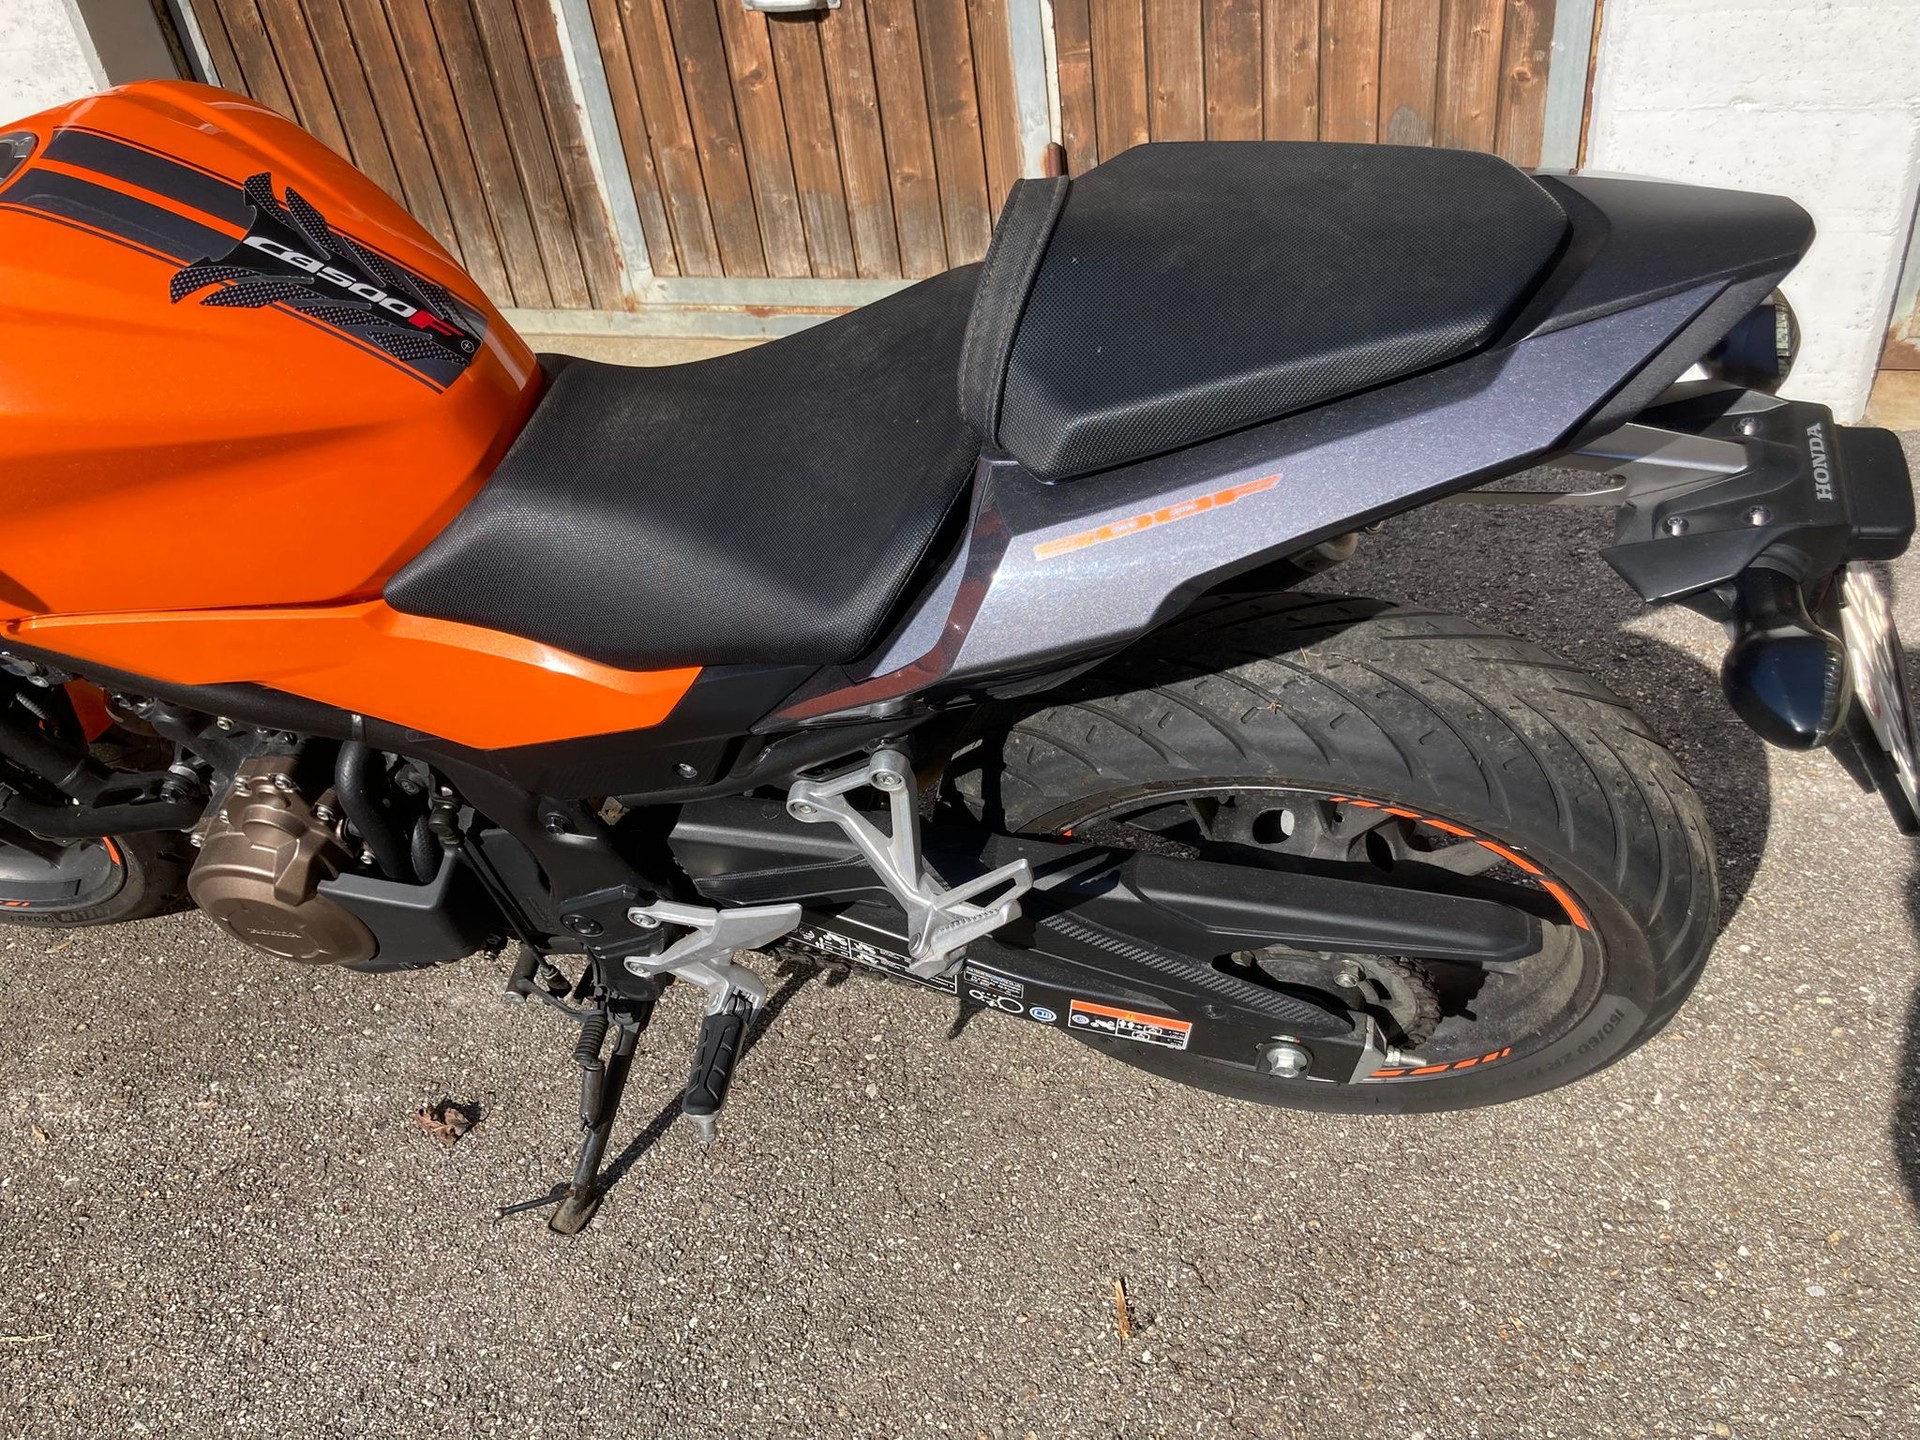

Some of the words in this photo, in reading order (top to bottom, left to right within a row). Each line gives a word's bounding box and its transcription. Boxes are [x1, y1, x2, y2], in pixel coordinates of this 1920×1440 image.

[242, 236, 464, 337] CB500F
[1806, 422, 1833, 500] HONDA
[1577, 1008, 1625, 1055] 160/60
